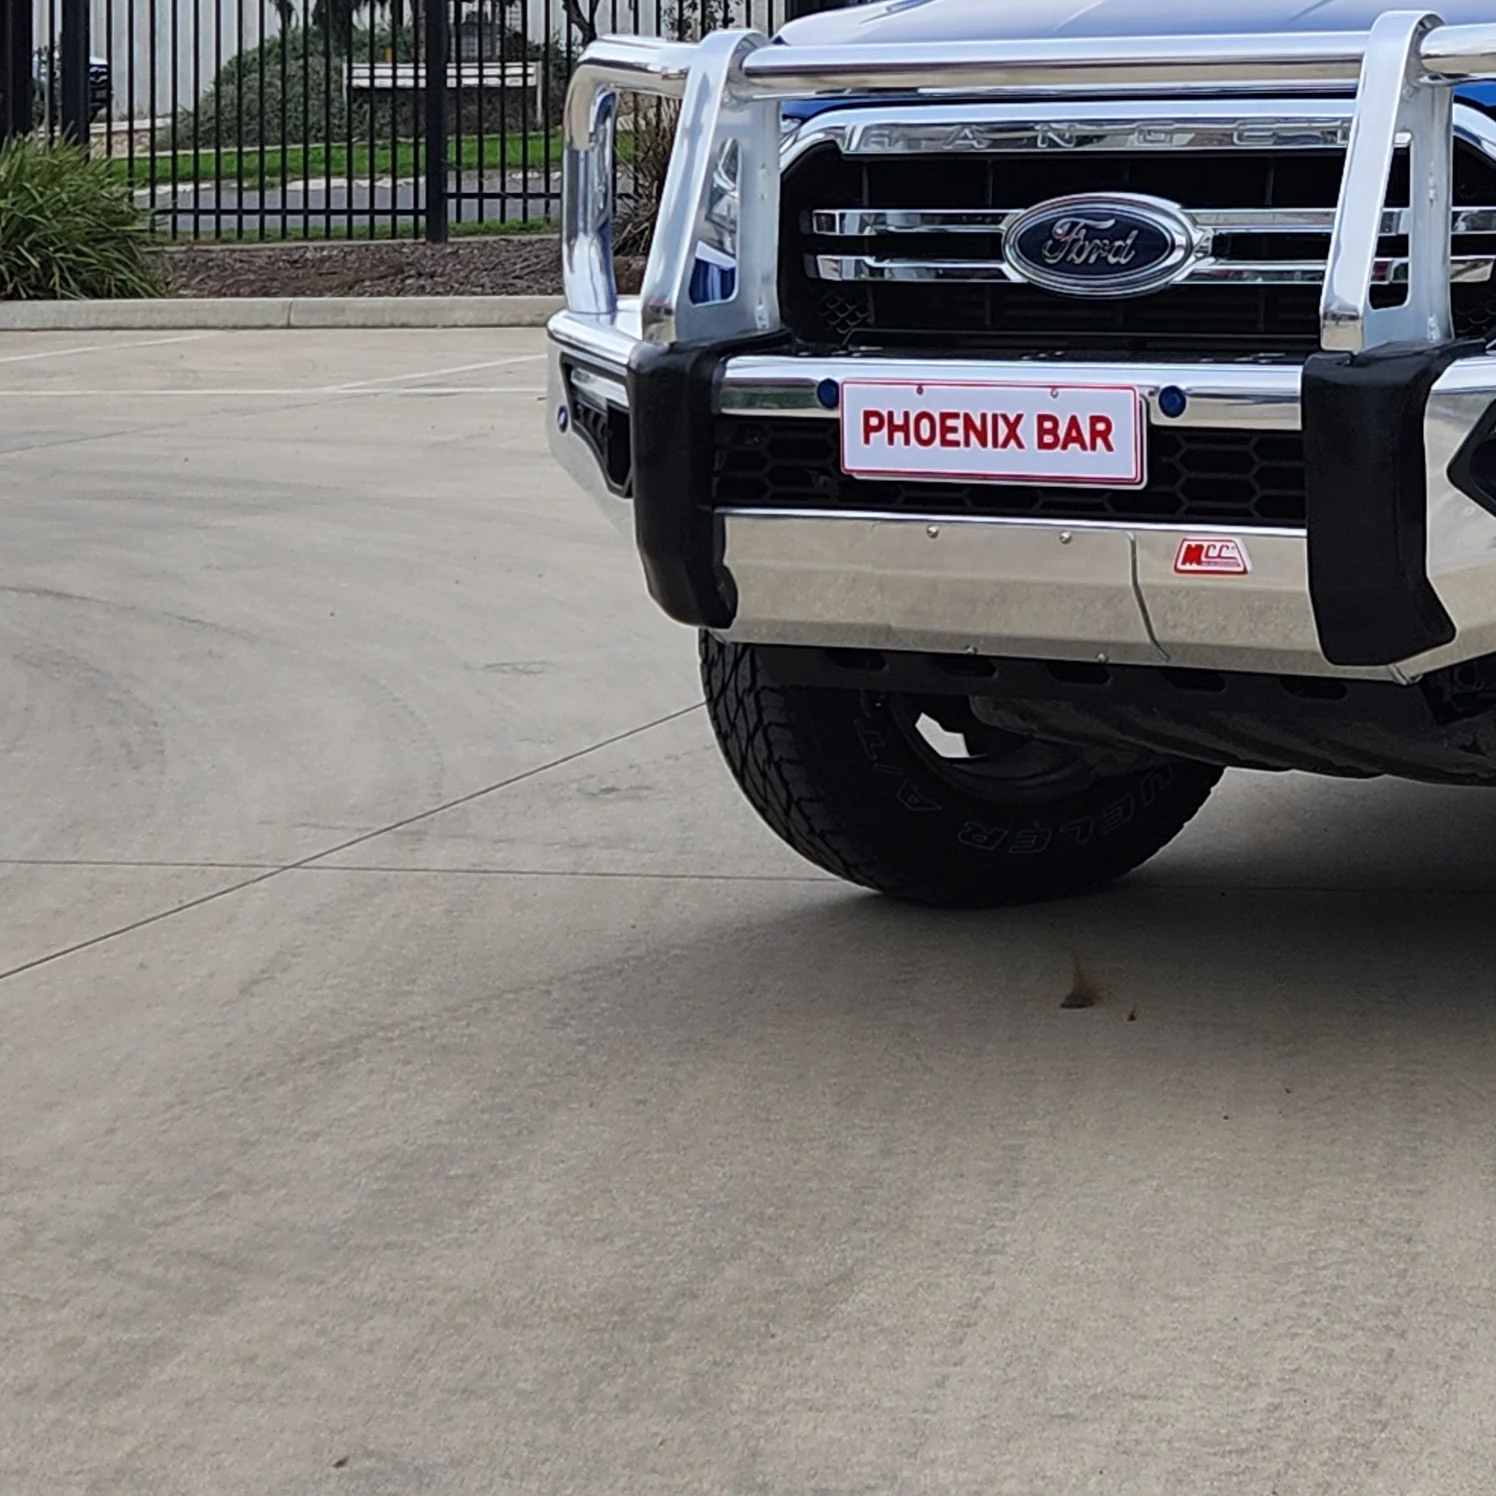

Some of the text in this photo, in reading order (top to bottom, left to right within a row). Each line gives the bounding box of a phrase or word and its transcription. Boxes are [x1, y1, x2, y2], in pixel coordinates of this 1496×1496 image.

[1041, 216, 1140, 265] Ford
[861, 409, 1115, 453] PHOENIX BAR
